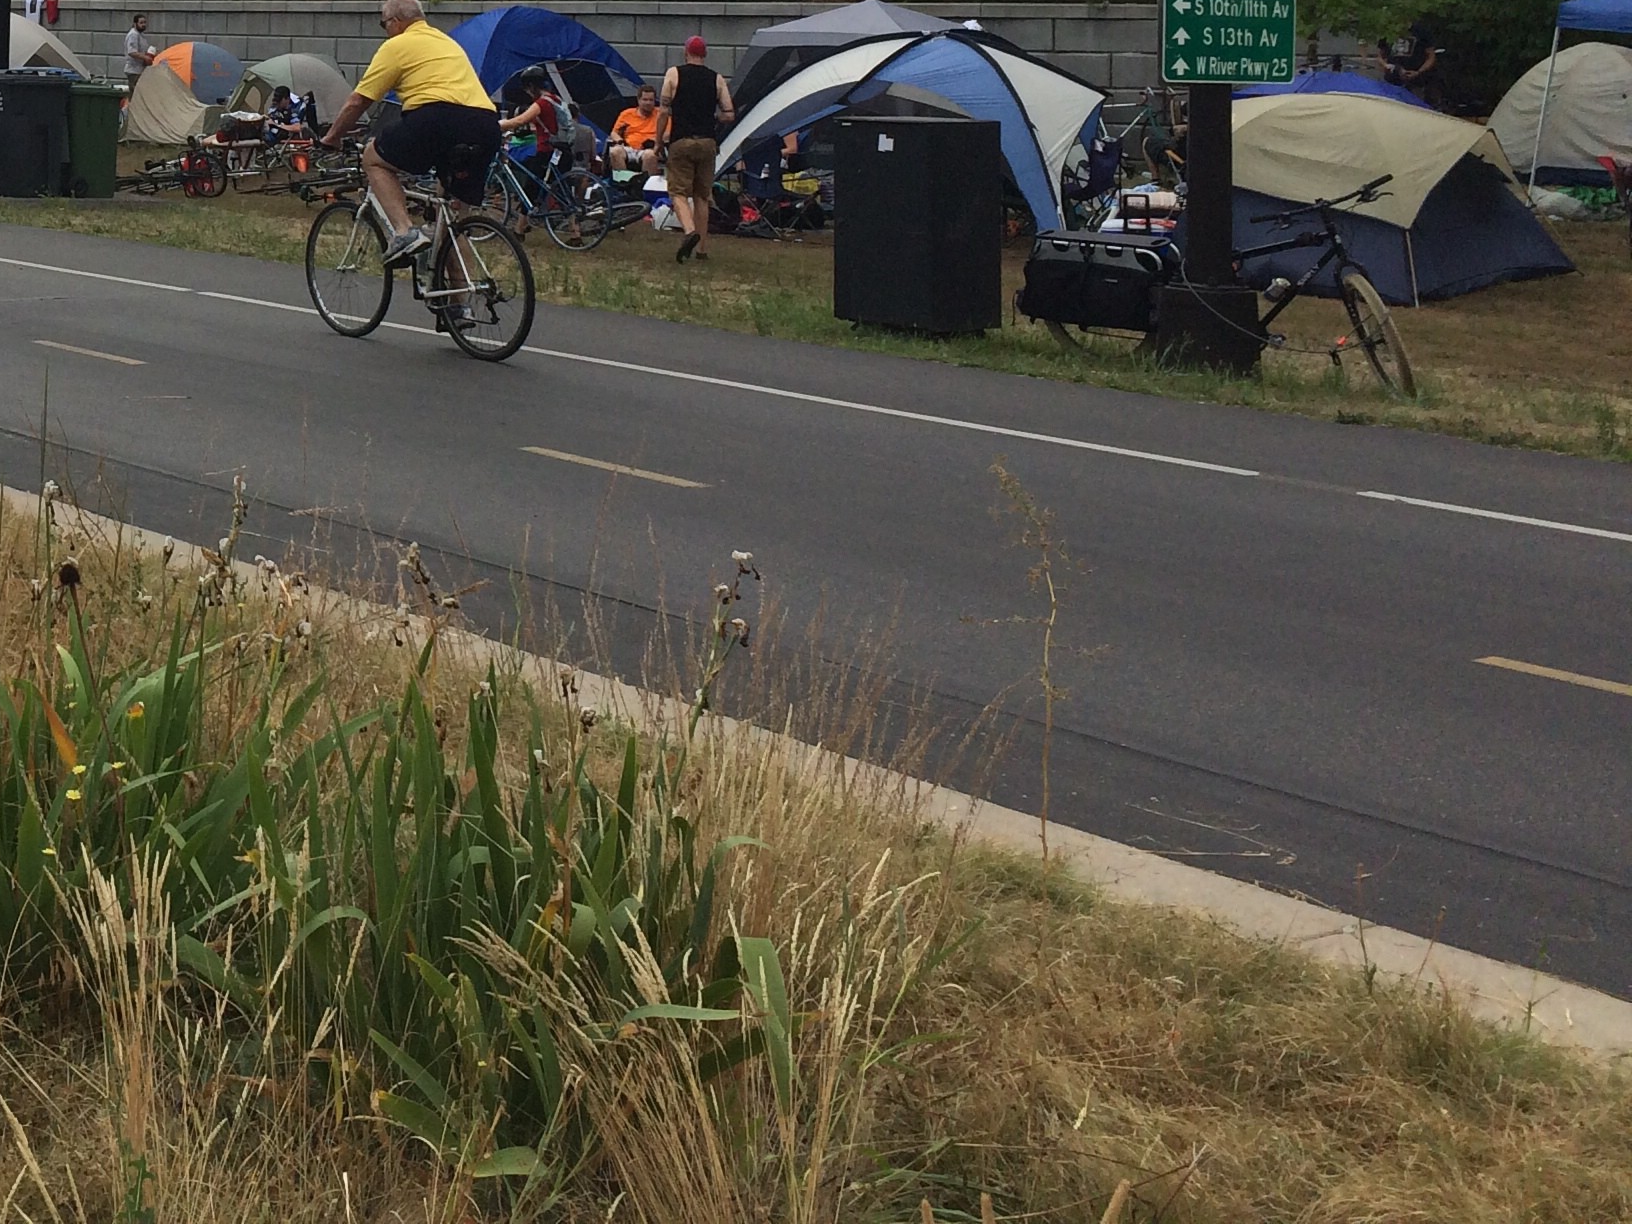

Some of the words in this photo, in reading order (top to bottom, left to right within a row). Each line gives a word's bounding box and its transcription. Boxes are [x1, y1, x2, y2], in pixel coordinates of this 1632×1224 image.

[1272, 0, 1289, 19] Av
[1203, 27, 1213, 45] S
[1220, 27, 1253, 46] 13th
[1259, 28, 1279, 47] Av
[1196, 56, 1207, 75] W
[1209, 56, 1238, 76] River
[1240, 57, 1269, 81] Pkwy
[1271, 58, 1288, 77] 25
